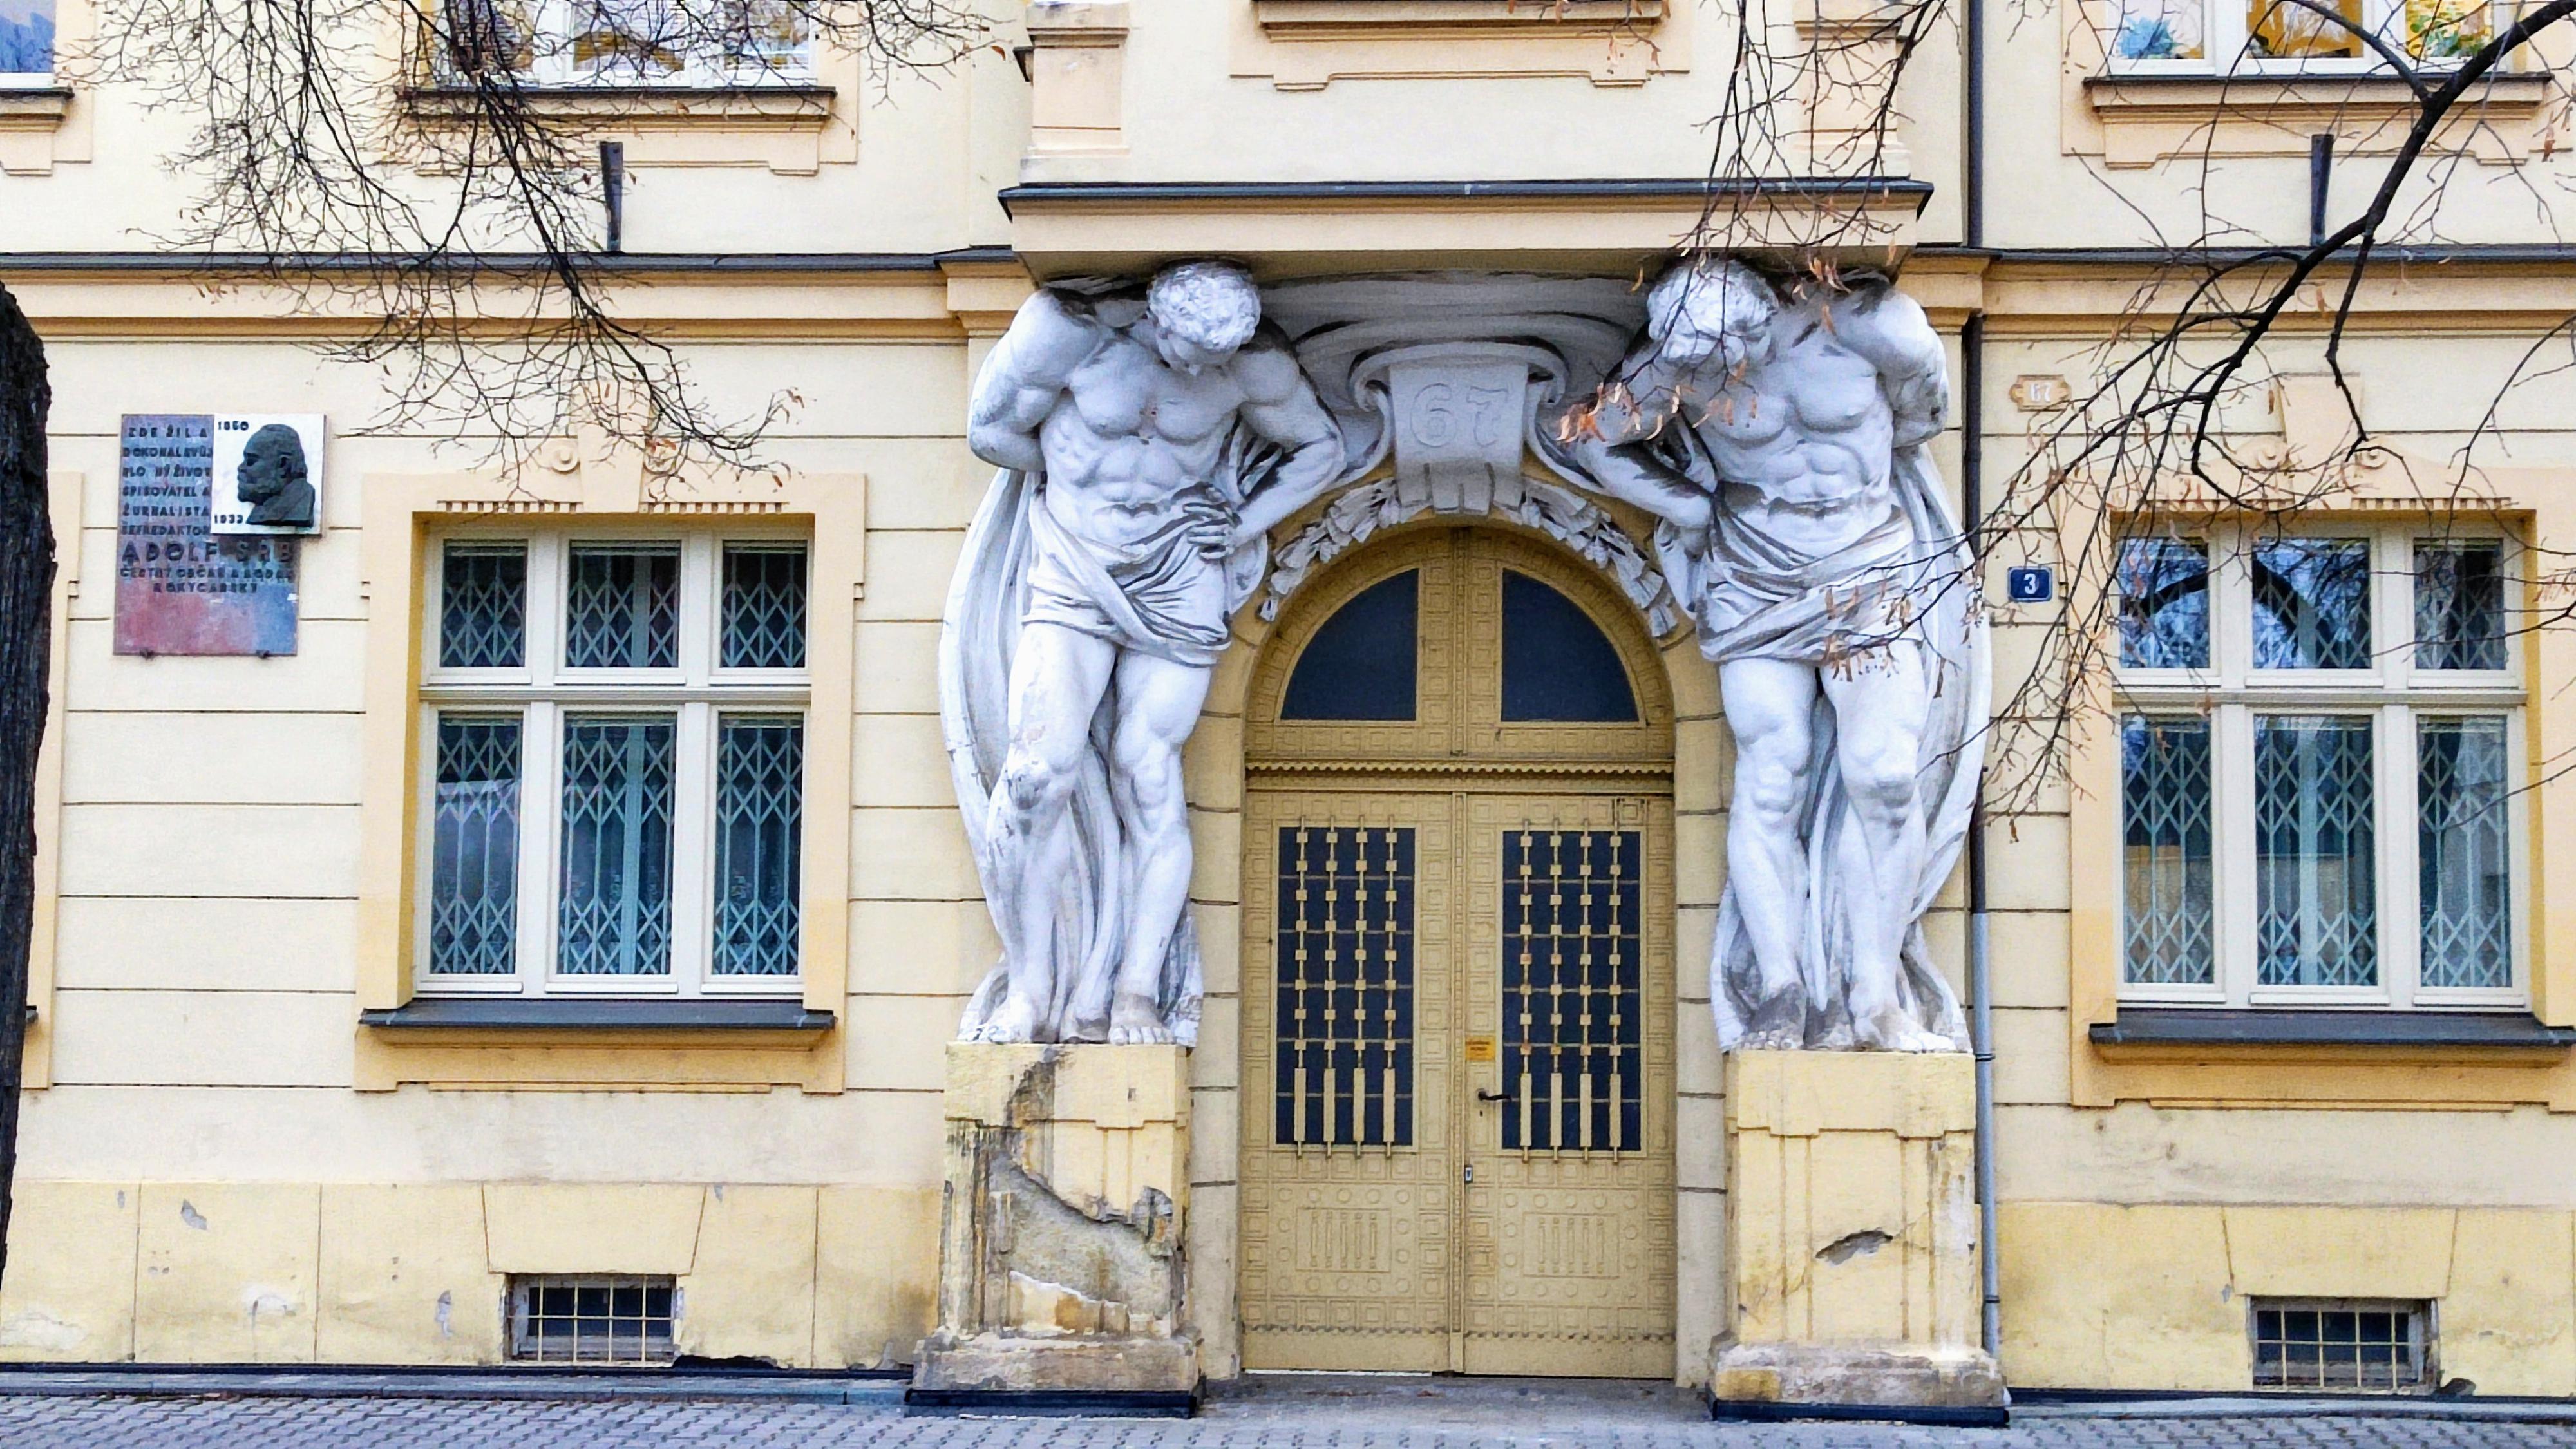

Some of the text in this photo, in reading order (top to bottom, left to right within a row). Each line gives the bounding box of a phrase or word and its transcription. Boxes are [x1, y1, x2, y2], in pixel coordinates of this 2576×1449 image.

[2030, 381, 2052, 402] 67
[1410, 383, 1509, 448] 67
[128, 427, 158, 438] ZDE
[199, 428, 207, 438] A
[218, 421, 249, 431] 1850
[121, 446, 182, 457] DOKONAL
[122, 486, 197, 497] SPISOVATEL
[122, 502, 211, 516] ŽURNALISTA
[122, 540, 218, 562] ADOLF
[2023, 573, 2036, 594] 3
